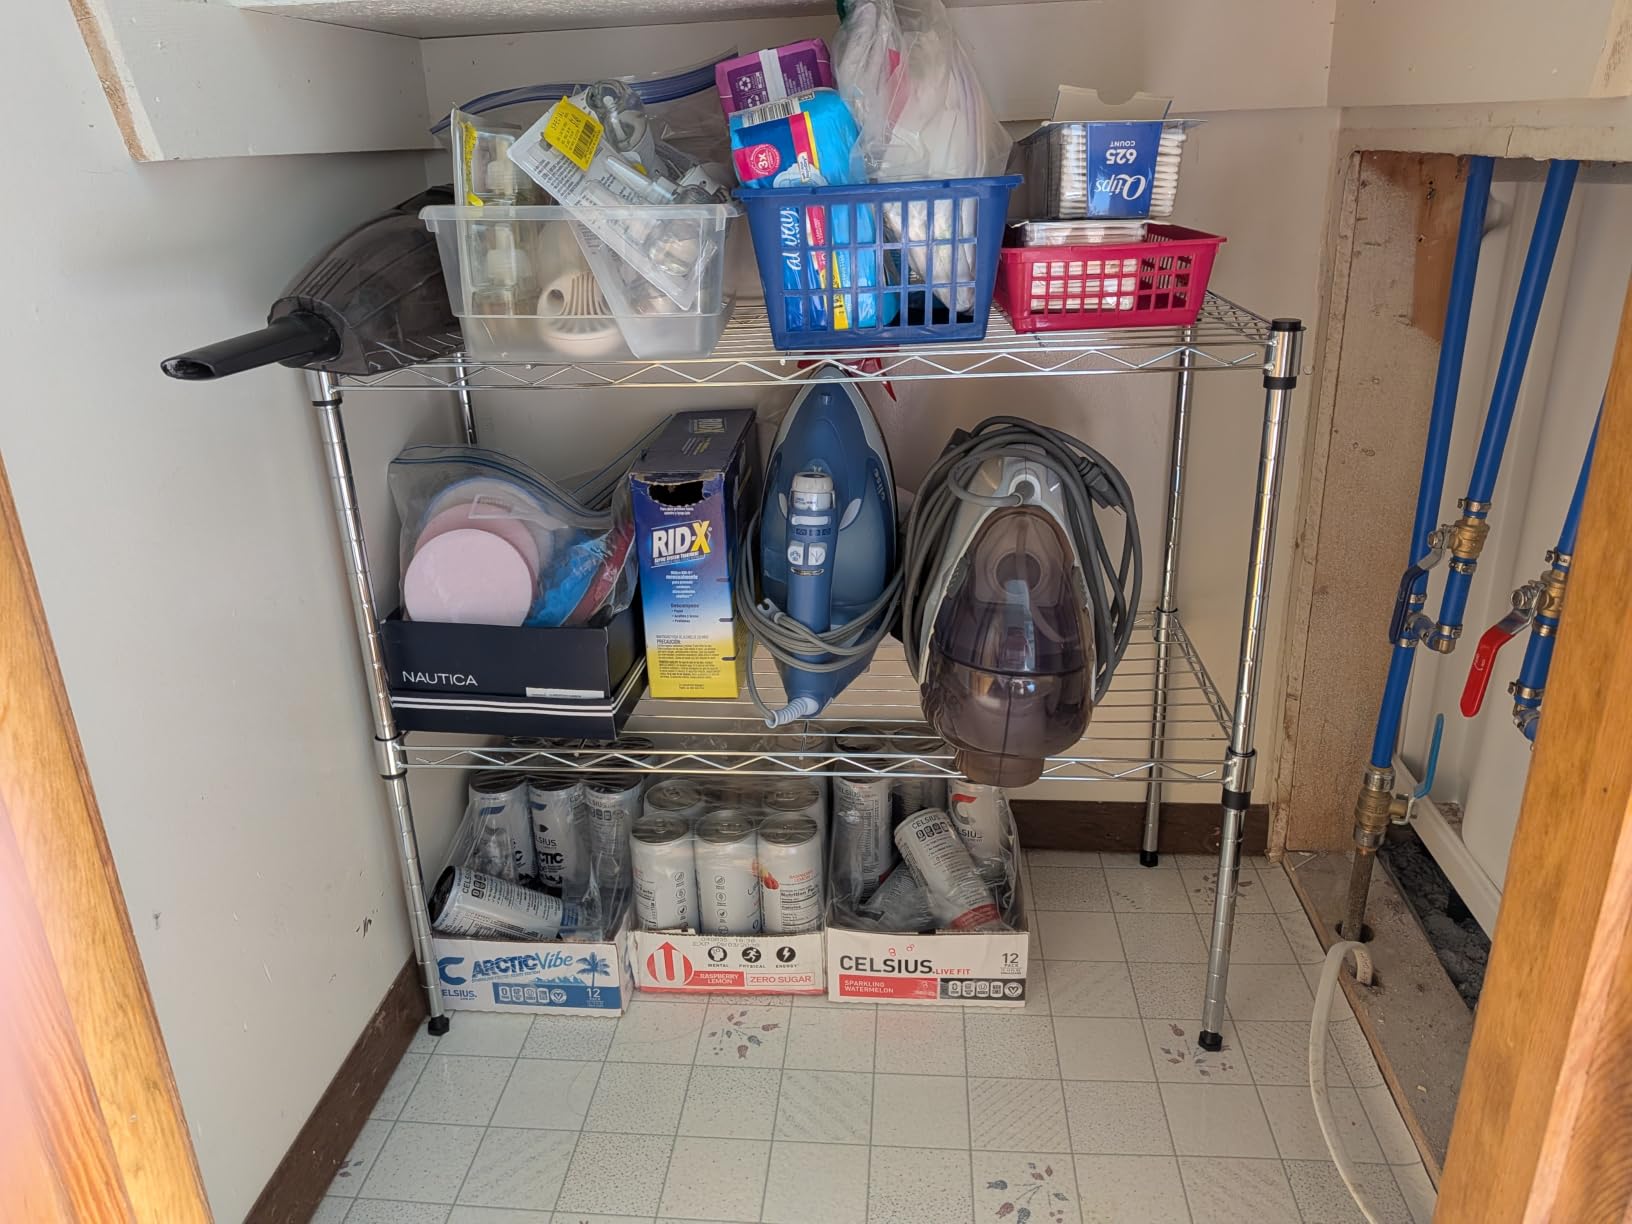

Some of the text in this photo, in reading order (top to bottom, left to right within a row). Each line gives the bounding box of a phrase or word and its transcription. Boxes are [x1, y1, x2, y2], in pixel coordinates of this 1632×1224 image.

[1106, 148, 1137, 165] 625
[652, 520, 711, 558] RID-X
[402, 671, 478, 686] NAUTICA
[535, 950, 574, 970] Vibe
[1002, 952, 1019, 964] 12
[750, 976, 812, 984] ZERO SUGAR
[844, 979, 885, 988] SPARKLING
[586, 988, 601, 998] 12
[844, 986, 894, 994] WATERMELON
